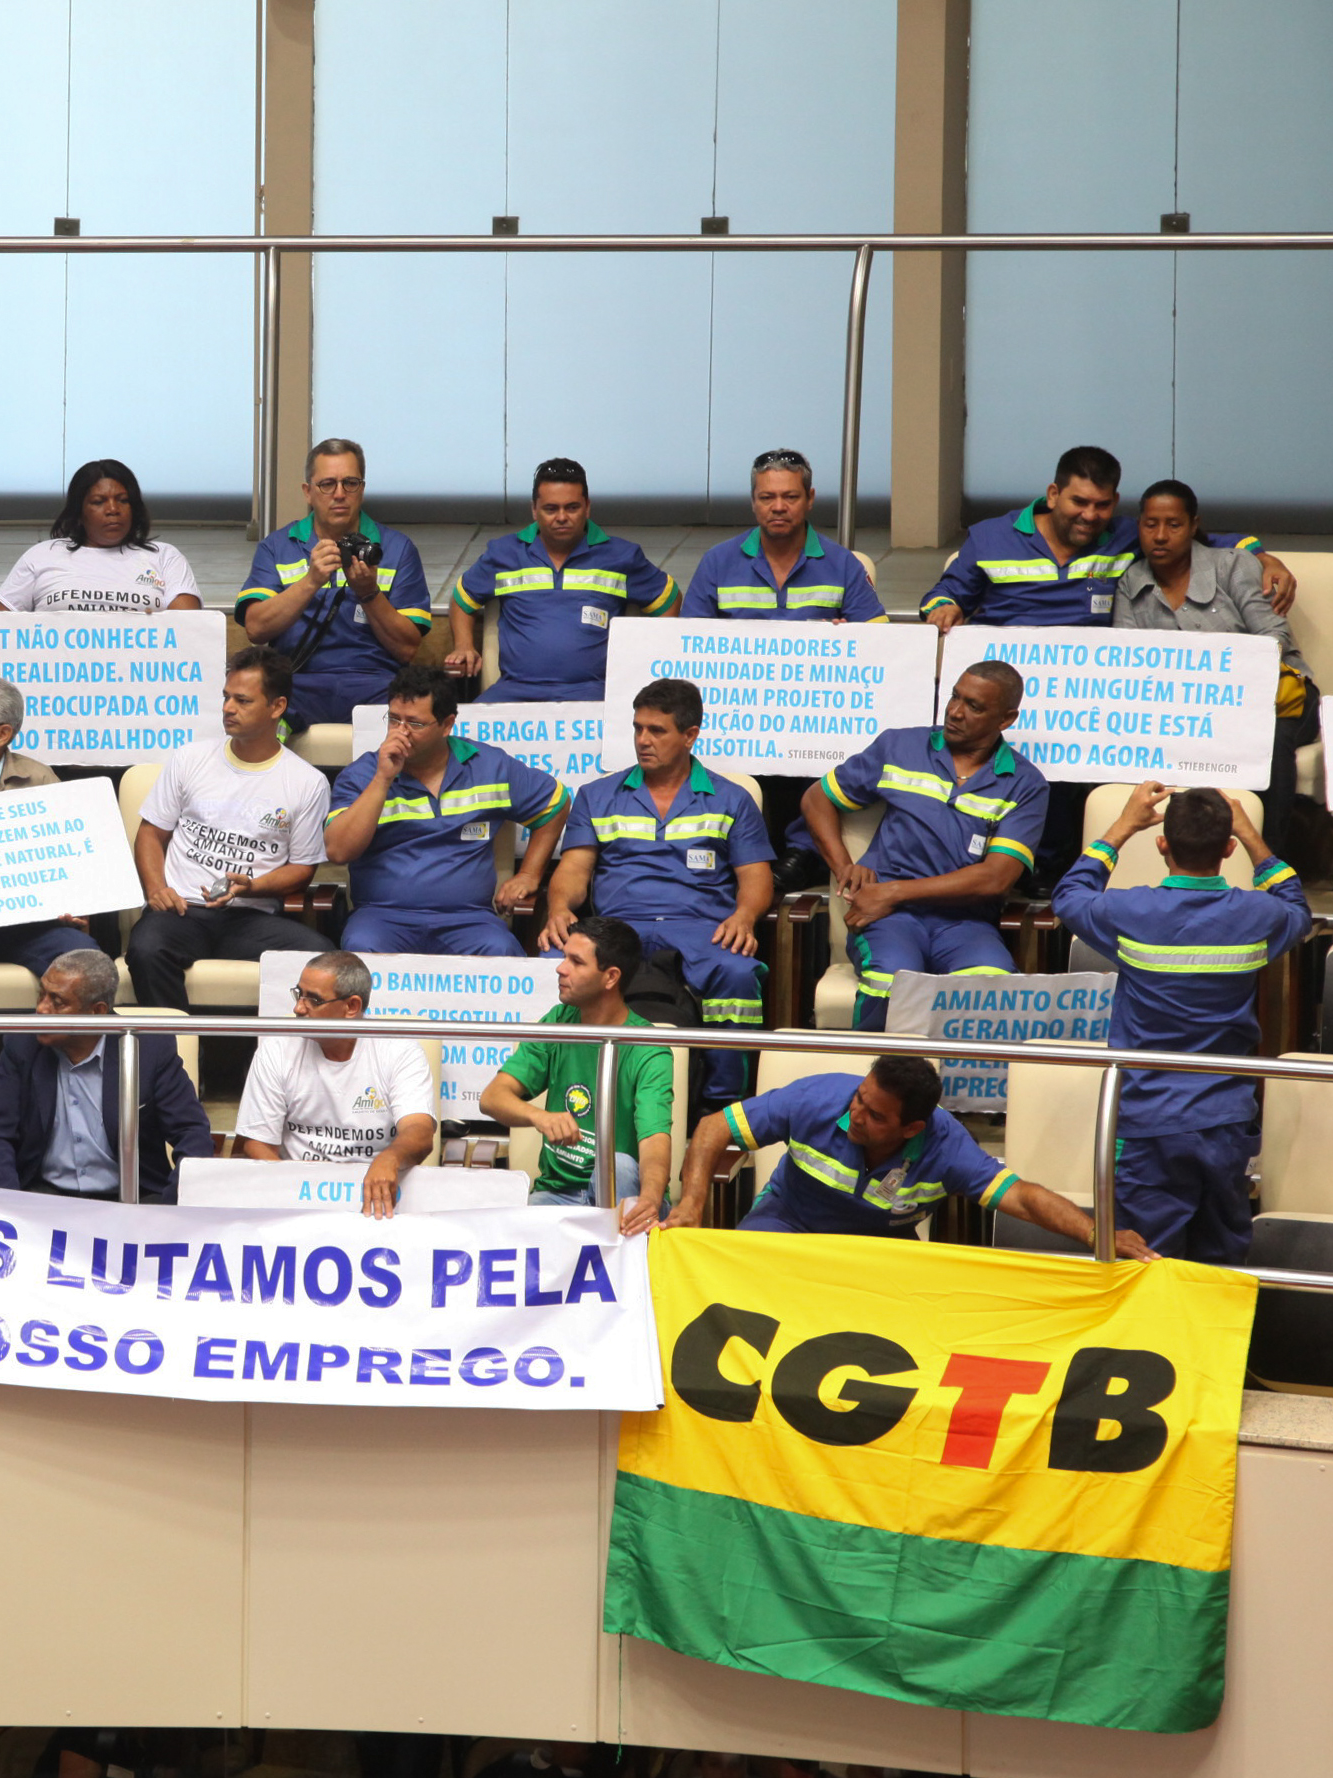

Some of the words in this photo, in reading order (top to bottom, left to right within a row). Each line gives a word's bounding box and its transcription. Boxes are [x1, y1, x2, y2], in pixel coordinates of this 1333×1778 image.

[47, 589, 151, 606] DEFENDEMOS
[17, 624, 59, 649] NÃO
[65, 628, 157, 649] CONHECE
[165, 628, 177, 648] A
[681, 636, 841, 657] TRABALHADORES
[847, 640, 855, 657] E
[983, 643, 1088, 666] AMIANTO
[1095, 646, 1212, 671] CRISOTILA
[1219, 647, 1231, 672] É
[3, 662, 123, 682] REALIDADE.
[131, 662, 202, 682] NUNCA
[651, 660, 775, 681] COMUNIDADE
[781, 664, 803, 681] DE
[810, 664, 884, 688] MINAÇU
[764, 689, 844, 708] PROJETO
[852, 692, 872, 709] DE
[1046, 677, 1058, 697] E
[1064, 676, 1174, 702] NINGUÉM
[1182, 682, 1244, 706] TIRA!
[26, 695, 148, 716] REOCUPADA
[156, 695, 198, 715] COM
[477, 721, 552, 742] BRAGA
[556, 721, 565, 740] E
[571, 719, 605, 741] SEU
[700, 709, 754, 734] BIÇÃO
[760, 714, 784, 732] DO
[790, 715, 878, 735] AMIANTO
[1046, 707, 1100, 732] VOCÊ
[1106, 711, 1152, 735] QUE
[1160, 712, 1213, 738] ESTÁ
[693, 738, 783, 758] RISOTILA.
[788, 749, 845, 761] STIEBENGOR
[1019, 742, 1081, 764] ANDO
[1087, 744, 1171, 769] AGORA.
[1178, 761, 1237, 774] STIEBENGOR
[8, 801, 47, 819] SEUS
[32, 822, 61, 838] SIM
[66, 818, 84, 832] AO
[182, 819, 266, 852] DEFENDEMOS
[4, 843, 81, 865] NATURAL,
[84, 837, 94, 853] É
[193, 838, 255, 863] AMIANTO
[1, 867, 69, 888] RIQUEZA
[388, 973, 502, 994] BANIMENTO
[509, 976, 533, 994] DO
[933, 990, 1051, 1012] AMIANTO
[944, 1019, 1065, 1040] GERANDO
[288, 1121, 384, 1141] DEFENDEMOS
[308, 1141, 374, 1157] AMIANTO
[299, 1181, 311, 1200] A
[318, 1182, 354, 1202] CUT
[47, 1230, 402, 1308] LUTAMOS
[431, 1244, 617, 1309] PELA
[193, 1335, 586, 1389] EMPREGO.
[671, 1302, 1176, 1474] CGTB
